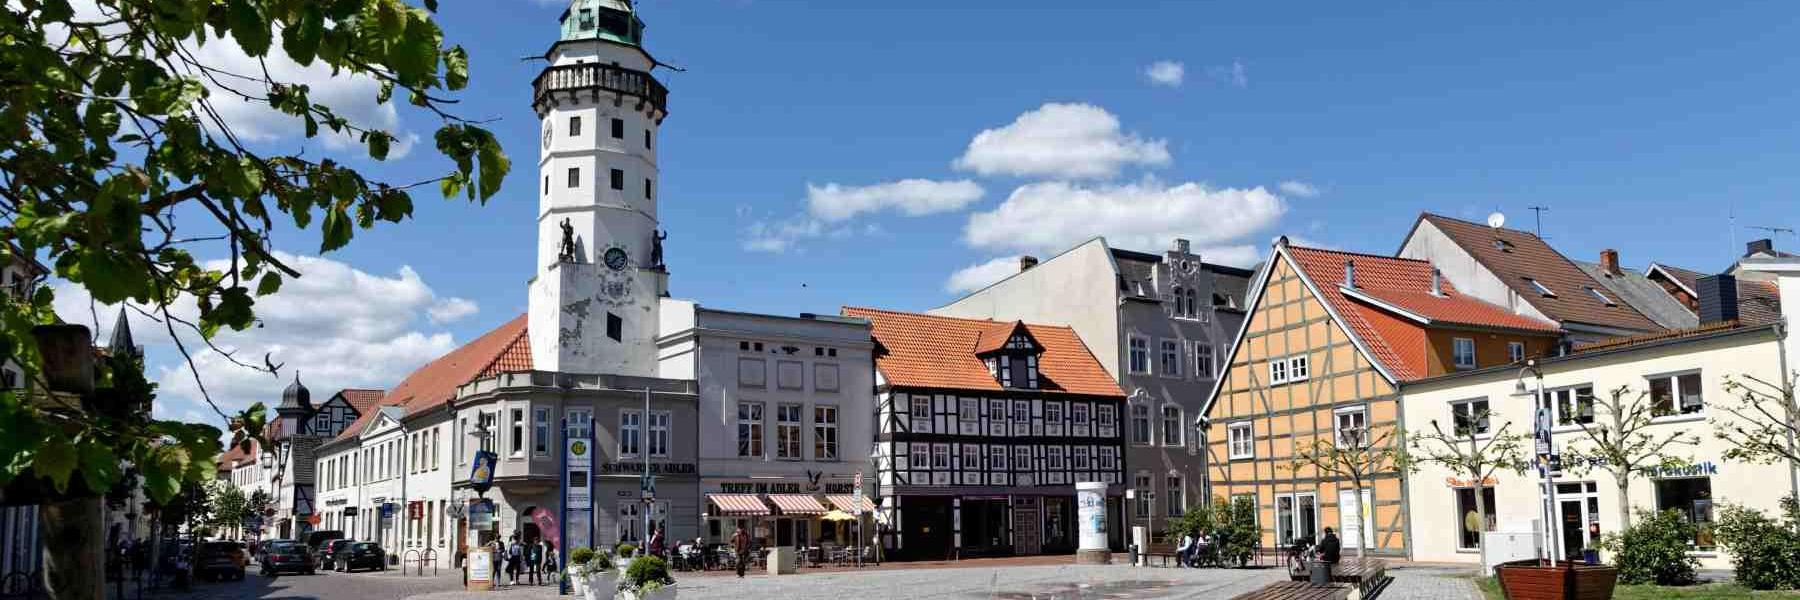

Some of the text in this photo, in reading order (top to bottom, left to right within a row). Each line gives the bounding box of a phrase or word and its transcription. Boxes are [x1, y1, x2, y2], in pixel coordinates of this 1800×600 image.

[663, 463, 696, 473] ADLER
[720, 482, 854, 494] TREFF IM ADLER HORST
